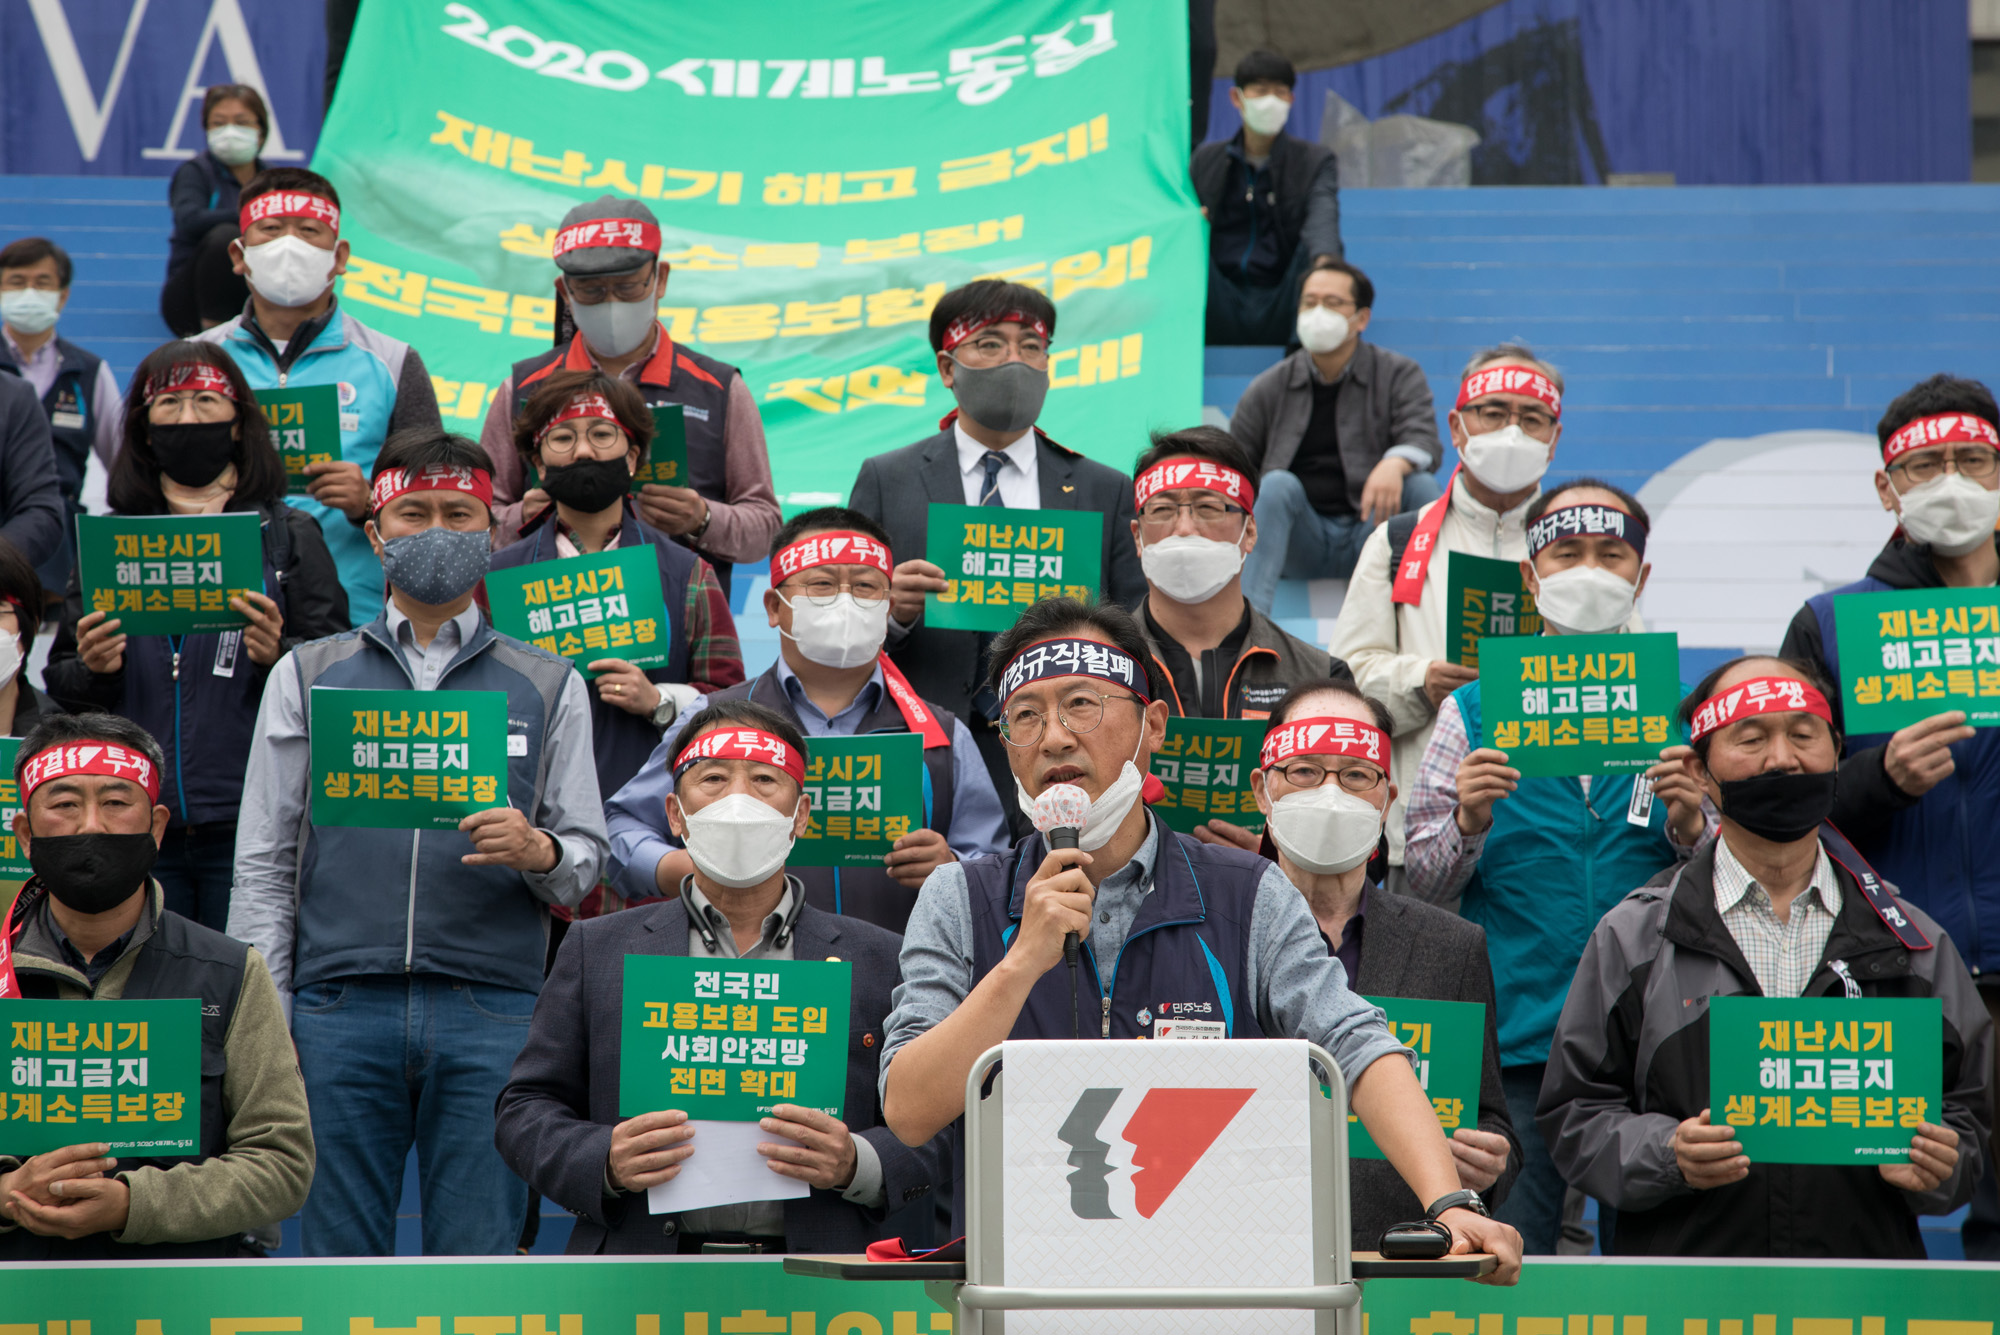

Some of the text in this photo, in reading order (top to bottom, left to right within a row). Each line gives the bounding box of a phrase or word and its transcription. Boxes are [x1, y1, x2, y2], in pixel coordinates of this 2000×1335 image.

[430, 109, 1109, 206] 재난시기 해고 금지!
[249, 192, 284, 222] 단결
[600, 221, 643, 247] 투쟁
[342, 254, 557, 340] 전국민
[1467, 368, 1504, 399] 단결
[421, 462, 474, 490] 투쟁
[1135, 462, 1241, 502] 단결 투쟁
[114, 533, 222, 557] 재난시기
[963, 523, 1064, 551] 재난시기
[779, 536, 888, 575] 단결 투쟁
[962, 551, 1063, 580] 해고금지
[115, 561, 222, 585] 해고금지
[522, 566, 624, 606] 재난시기
[92, 588, 250, 612] 생계소득보장
[527, 593, 629, 634] 해고금지
[1878, 605, 2000, 638] 재난시기
[525, 618, 657, 657] 계소득보장
[1520, 652, 1636, 682] 재난시기
[1881, 637, 2000, 670] 해고금지
[1522, 684, 1638, 714] 해고금지
[1746, 681, 1807, 711] 투쟁
[1854, 669, 2000, 704] 생계소득보
[352, 710, 468, 738] 재난시기
[1493, 716, 1669, 748] 생계소득보장
[352, 742, 469, 770] 해고금지
[734, 731, 786, 767] 투쟁
[1157, 733, 1242, 760] 난시기
[1261, 722, 1380, 766] 단결 투쟁
[24, 746, 151, 791] 단결 투쟁
[804, 755, 881, 781] 난시기
[1155, 758, 1240, 787] 고금지
[324, 772, 498, 803] 생계소득보장
[803, 786, 881, 811] 고금지
[1157, 784, 1260, 814] 소득보장
[801, 816, 911, 841] 소득보장
[694, 971, 780, 1000] 전국민
[642, 1002, 828, 1034] 고용보험 도입
[1172, 1002, 1212, 1013] 민주노총
[11, 1022, 148, 1051] 재난시기
[662, 1035, 808, 1066] 사회안전망
[1759, 1021, 1893, 1052] 재난시기
[11, 1057, 148, 1087] 해고금지
[670, 1068, 796, 1098] 전면 확대
[1759, 1057, 1893, 1090] 해고금지
[0, 1092, 186, 1124] 계소득보장
[1724, 1095, 1928, 1128] 생계소득보장
